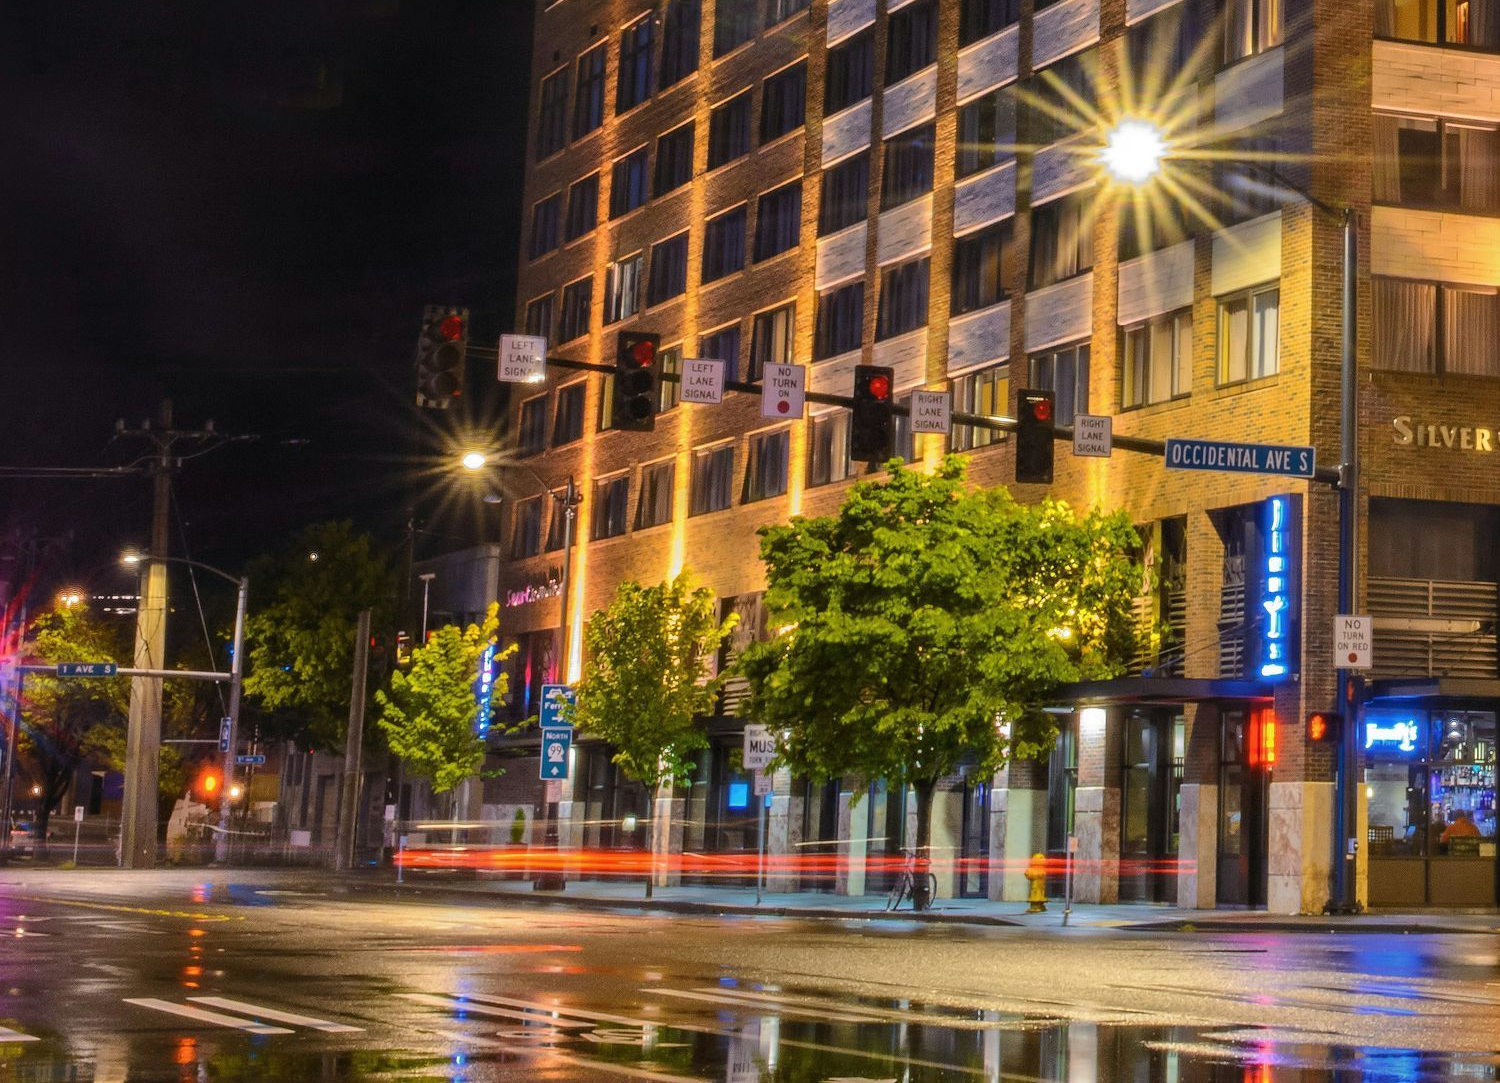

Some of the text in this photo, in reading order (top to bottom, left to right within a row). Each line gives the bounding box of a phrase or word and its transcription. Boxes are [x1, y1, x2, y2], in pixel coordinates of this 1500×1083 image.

[511, 340, 535, 350] LEFT
[509, 354, 535, 364] LANE
[691, 363, 714, 374] LEFT
[778, 367, 792, 377] NO
[689, 377, 715, 387] LANE
[772, 378, 798, 389] TURN
[684, 388, 718, 401] SIGNAL
[778, 389, 790, 398] ON
[918, 394, 944, 405] RIGHT
[918, 407, 942, 417] LANE
[914, 419, 946, 430] SIGNAL
[1080, 419, 1105, 429] RIGHT
[1080, 431, 1104, 441] LANE
[1392, 416, 1494, 453] SILVER
[1077, 443, 1108, 454] SIGNAL
[1172, 444, 1309, 472] OCCIDENTAL AVE S
[1344, 619, 1361, 630] NO
[1343, 631, 1364, 640] TURN
[1337, 642, 1369, 652] ON RED
[75, 665, 94, 674] AVE
[104, 665, 112, 674] S
[546, 731, 569, 740] NORTH
[550, 745, 562, 756] 99
[749, 739, 775, 754] MUS
